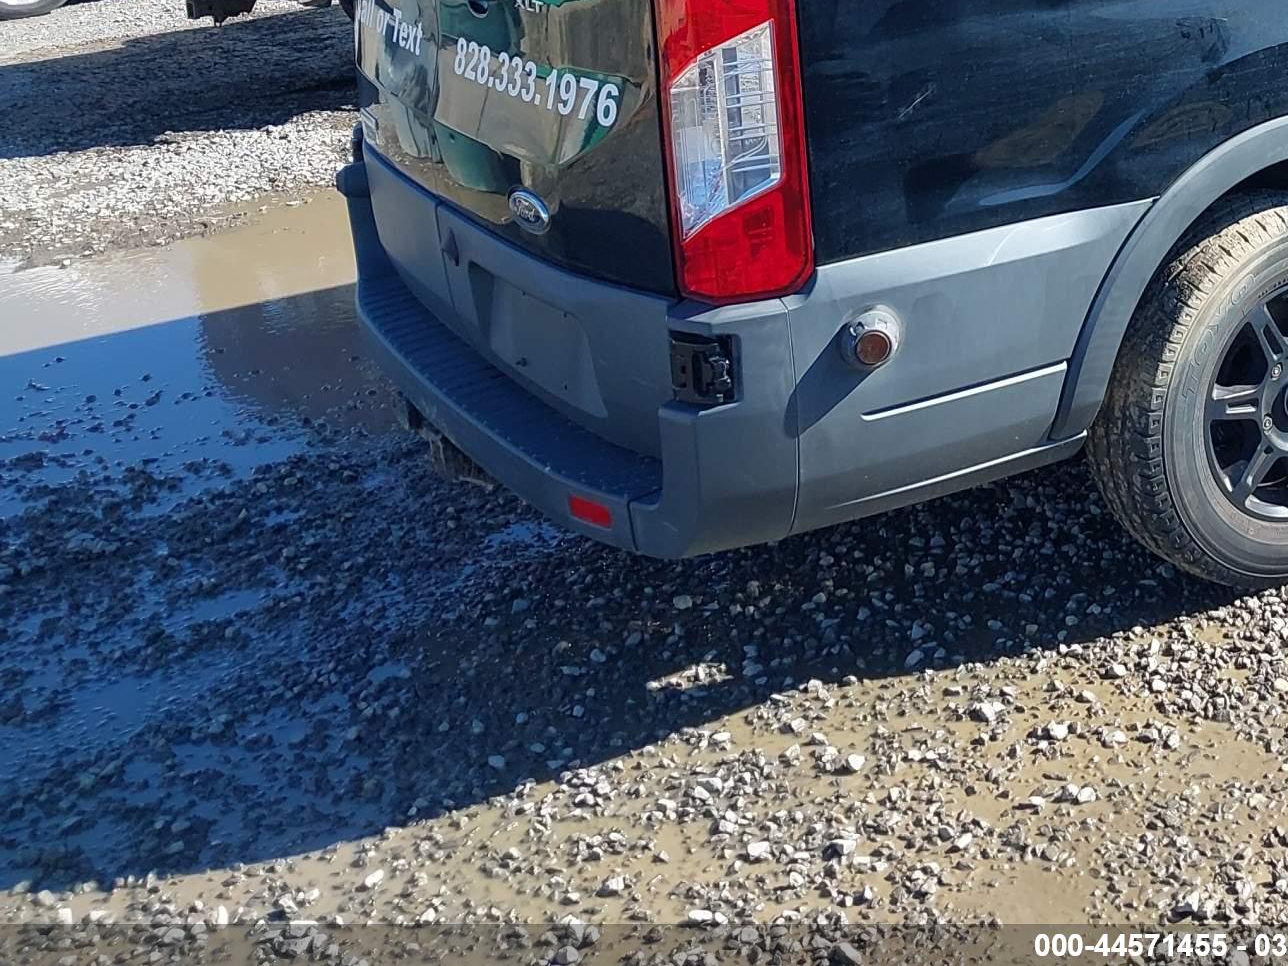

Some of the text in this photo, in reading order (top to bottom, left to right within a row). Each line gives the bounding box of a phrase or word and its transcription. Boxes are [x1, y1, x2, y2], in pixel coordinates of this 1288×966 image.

[376, 8, 391, 36] or
[392, 7, 424, 56] Text
[454, 37, 620, 127] 828.333.1976
[514, 198, 537, 222] Ford
